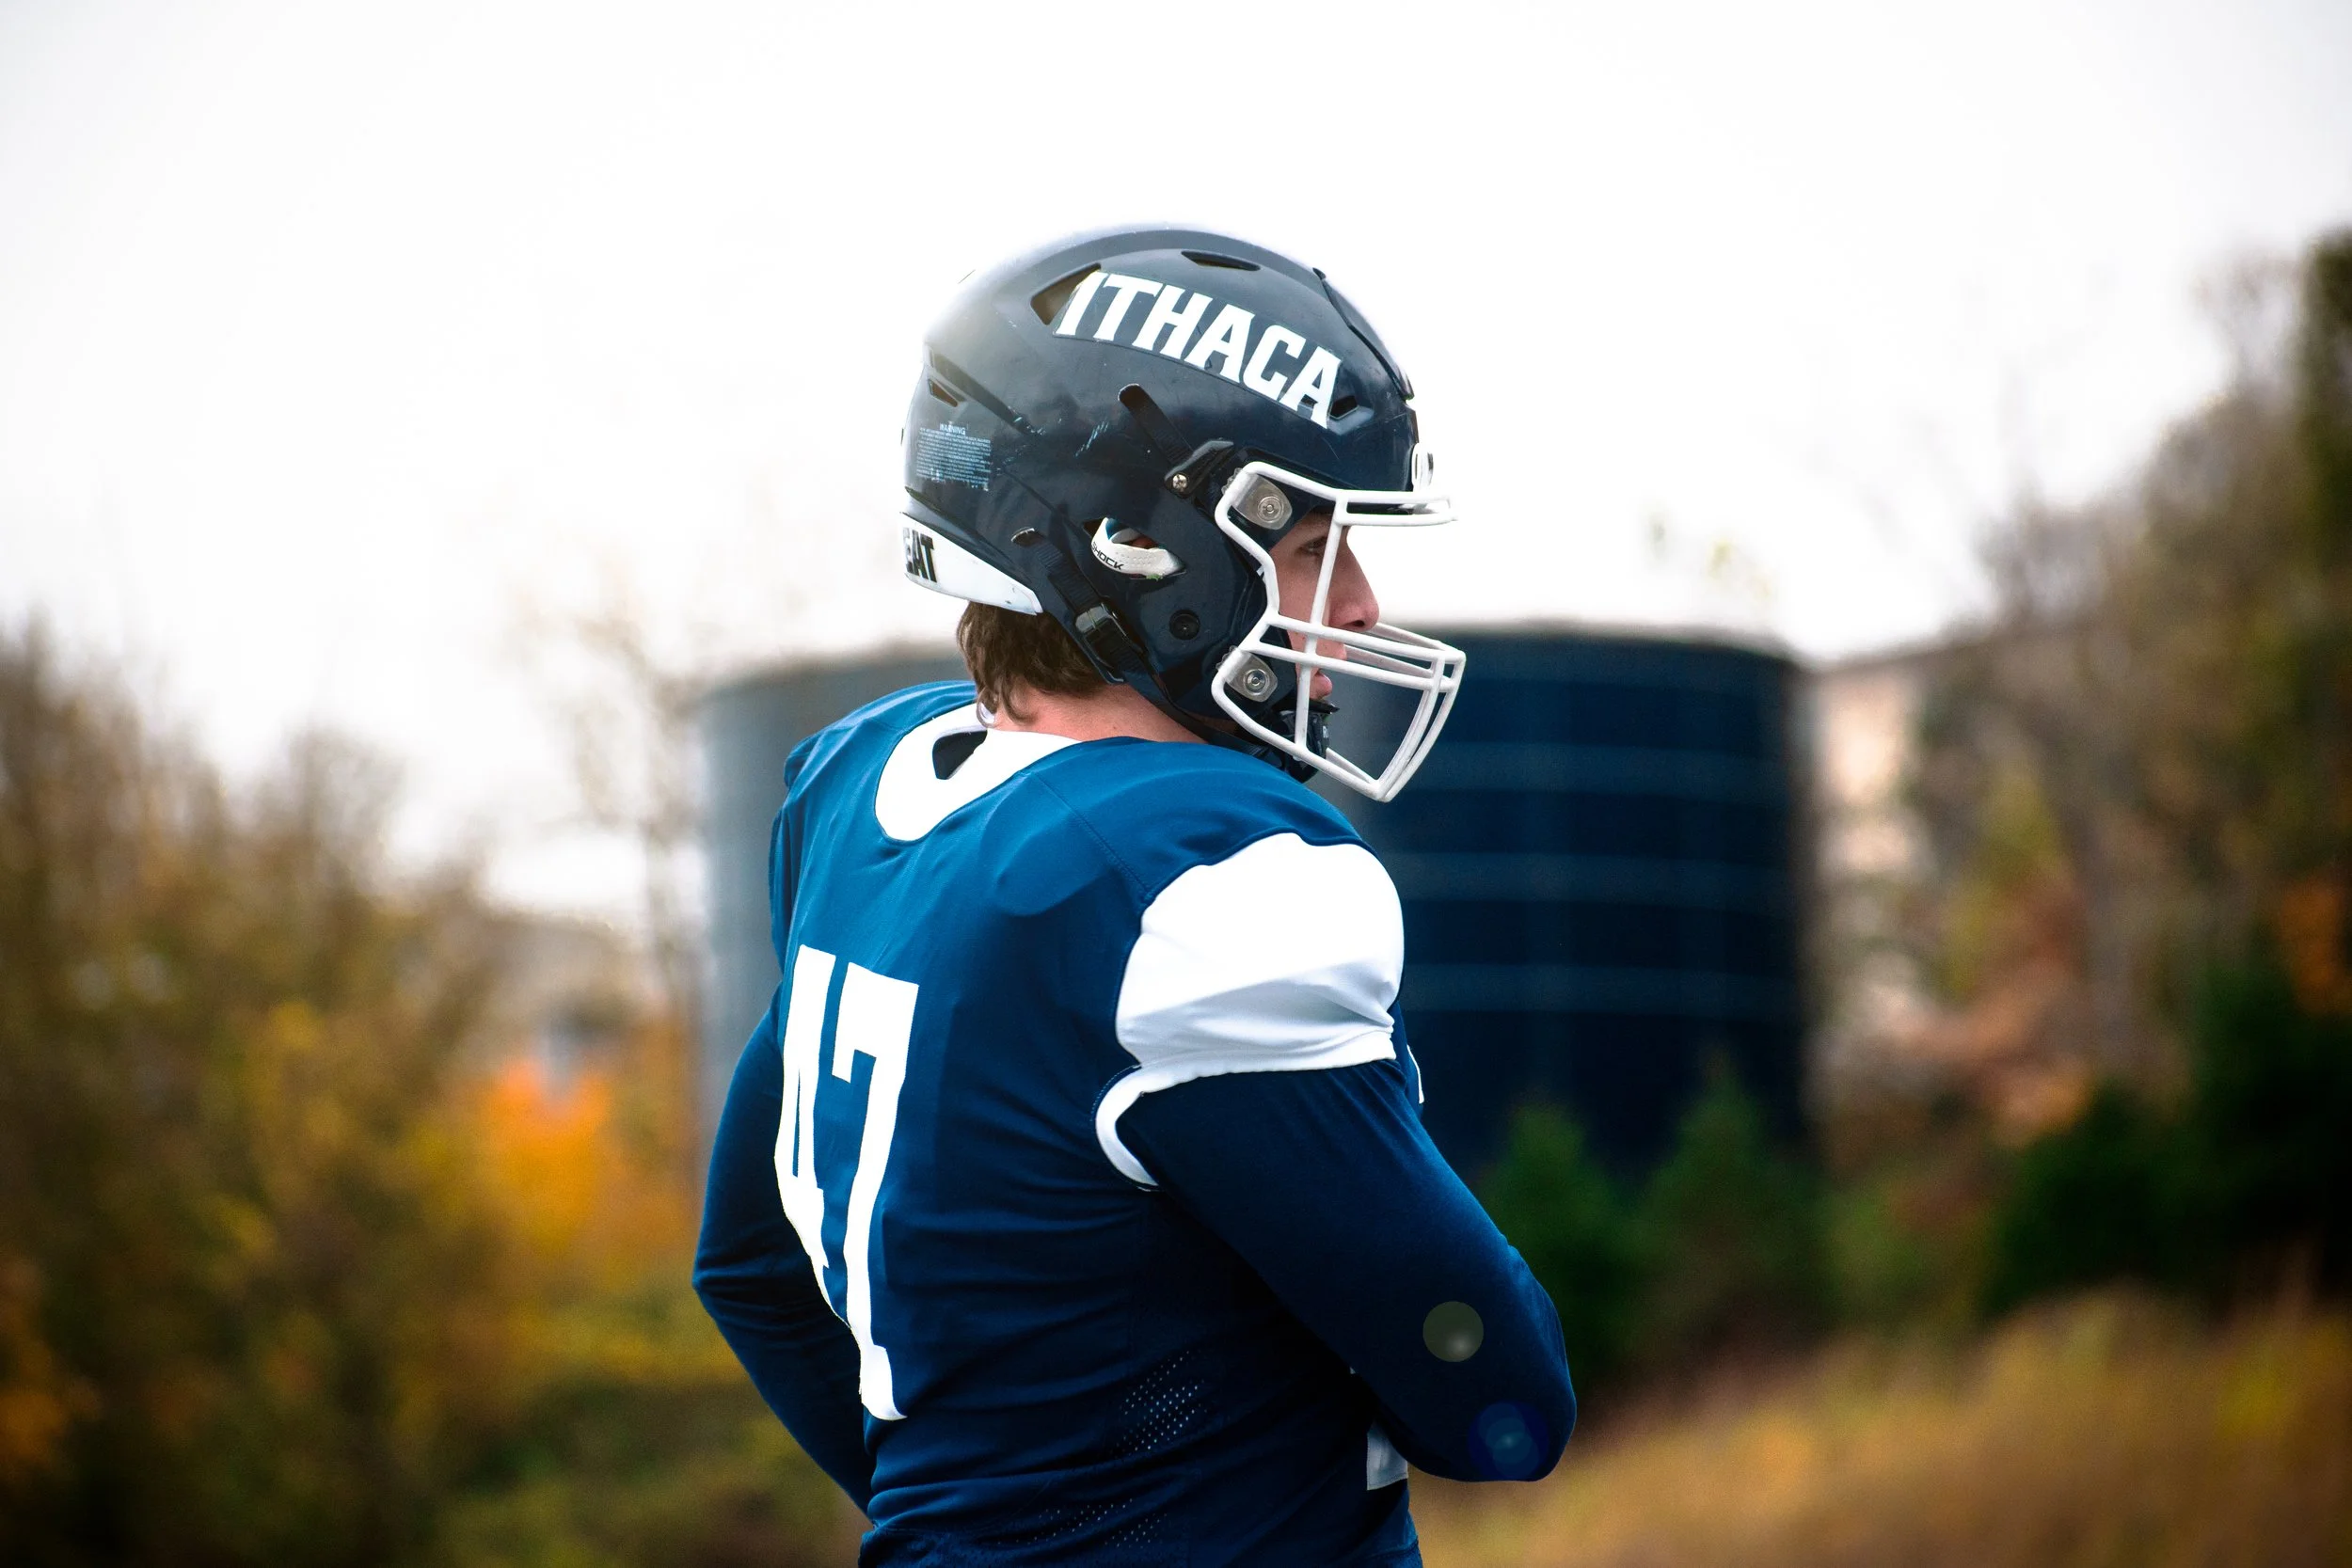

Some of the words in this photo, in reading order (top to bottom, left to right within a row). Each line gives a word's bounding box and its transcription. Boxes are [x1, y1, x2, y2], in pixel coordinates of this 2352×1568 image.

[1056, 271, 1342, 429] ITHACA
[1091, 541, 1124, 570] SHOCK
[773, 943, 919, 1421] 47
